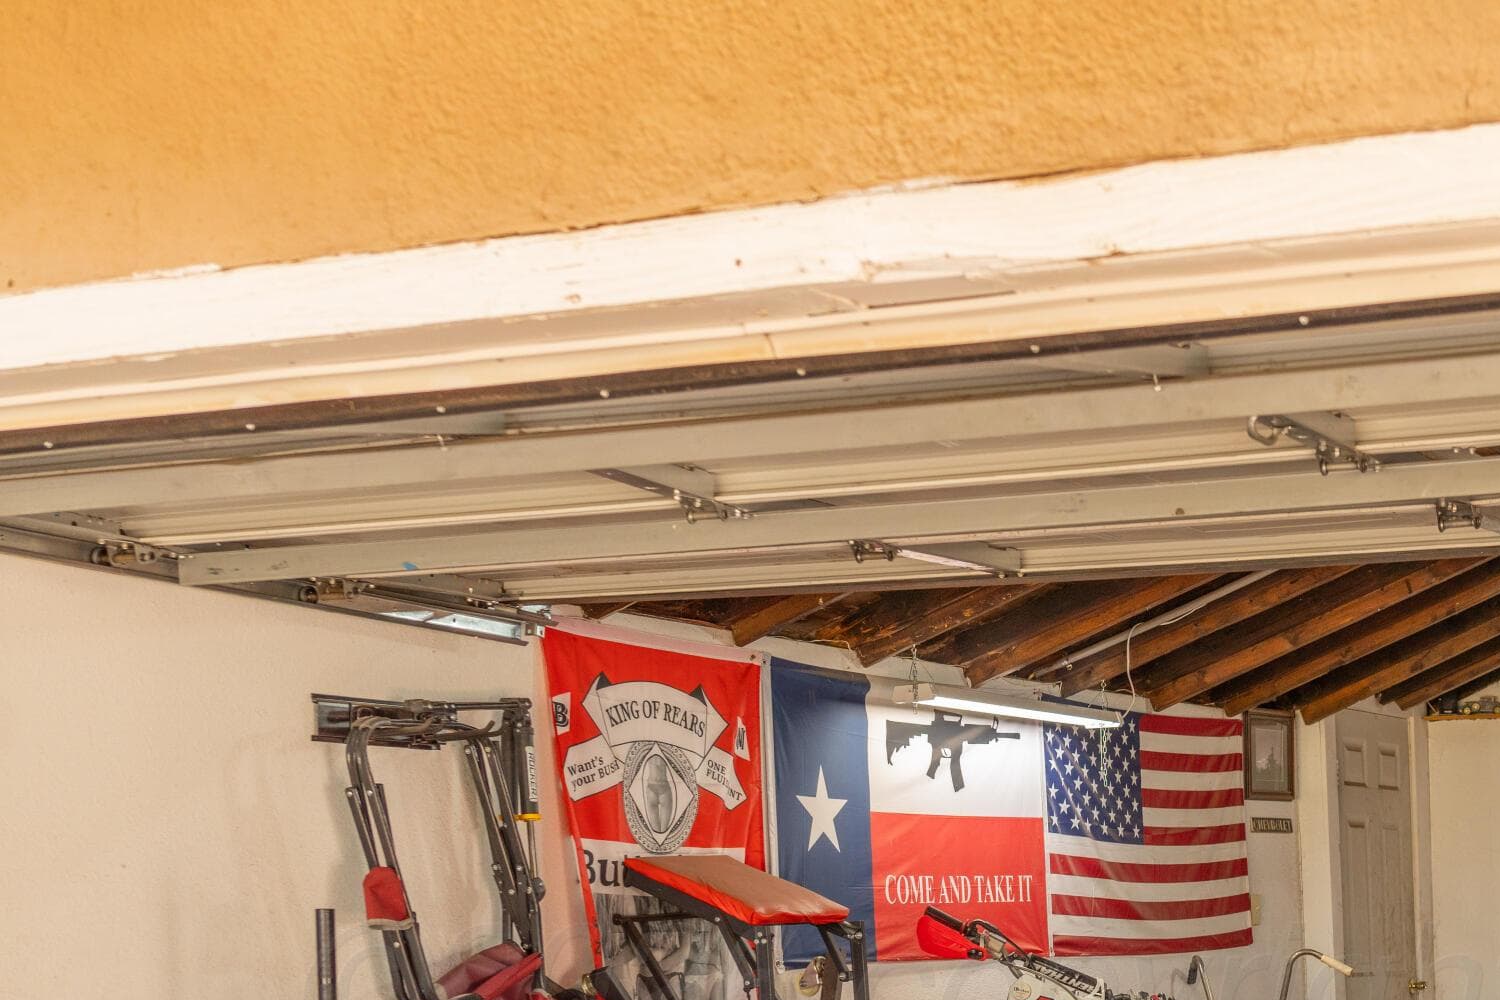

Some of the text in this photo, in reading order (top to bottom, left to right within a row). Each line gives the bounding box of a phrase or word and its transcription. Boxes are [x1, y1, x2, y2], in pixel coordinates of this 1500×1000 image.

[606, 700, 706, 738] KING OF REARS
[567, 755, 605, 777] Want's
[707, 759, 727, 776] ONE
[572, 774, 597, 792] your
[884, 874, 1033, 905] COME AND TAKE IT
[1034, 962, 1096, 995] RENTHA
